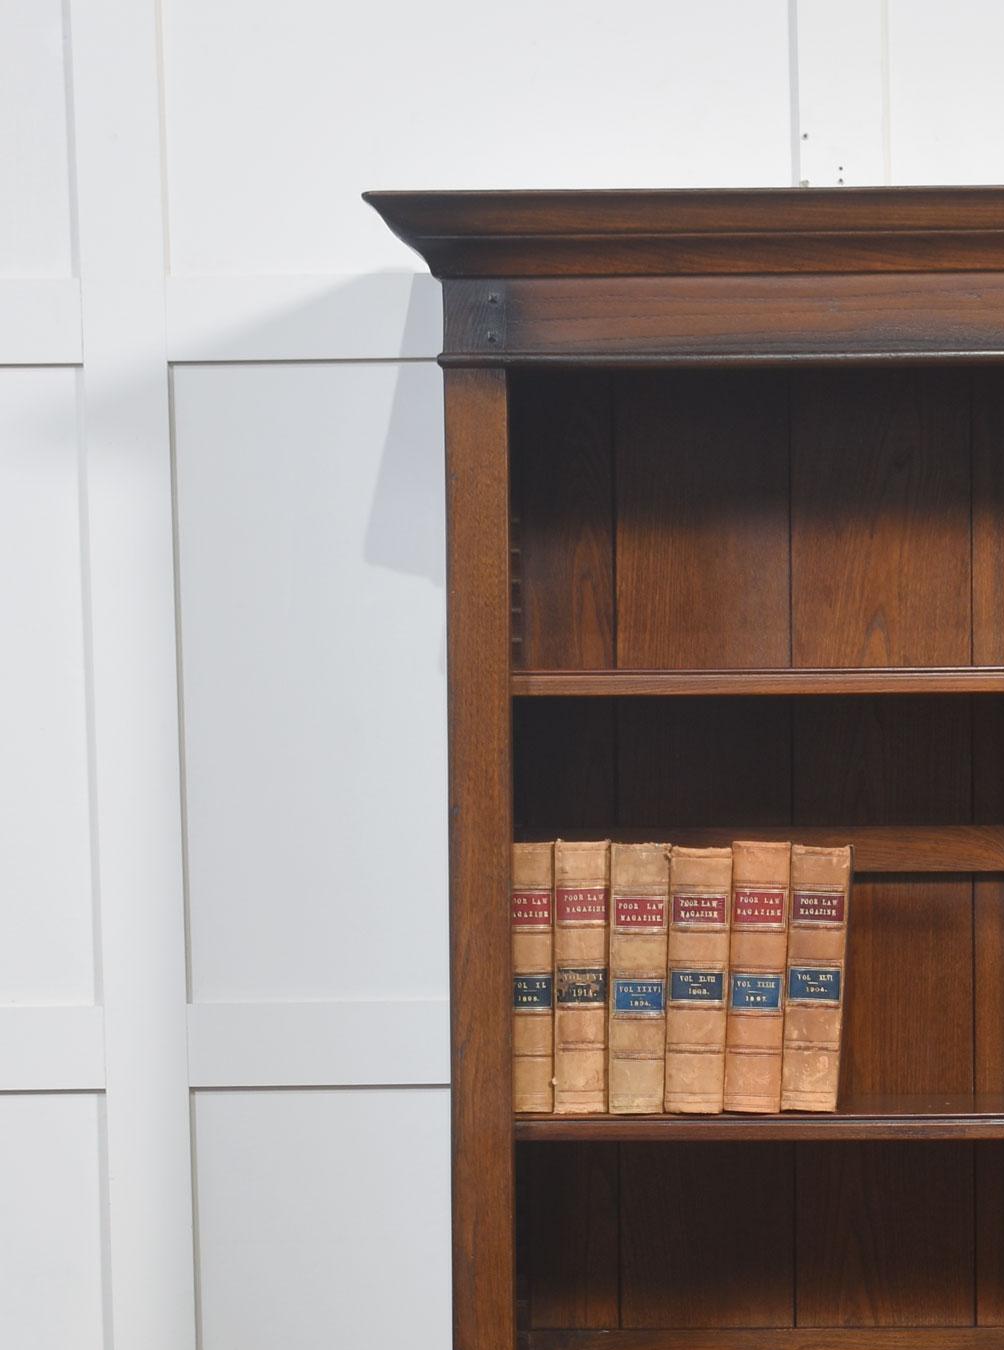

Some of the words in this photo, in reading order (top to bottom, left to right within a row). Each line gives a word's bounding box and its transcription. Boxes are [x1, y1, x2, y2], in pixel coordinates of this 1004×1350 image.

[564, 894, 584, 902] POOR
[587, 893, 605, 901] LAW
[739, 896, 759, 904] POOR
[764, 897, 780, 905] LAW
[618, 902, 639, 910] POOR
[646, 902, 664, 910] LAW
[679, 899, 698, 908] POOR
[701, 900, 718, 908] LAW
[566, 905, 606, 913] MAGAZINE
[737, 908, 782, 916] MAGAZINE
[800, 908, 837, 916] MAGAZINE
[620, 914, 662, 922] MAGAZINE
[680, 910, 719, 918] MAGAZINE
[797, 973, 812, 981] VOL
[737, 980, 752, 988] VOL
